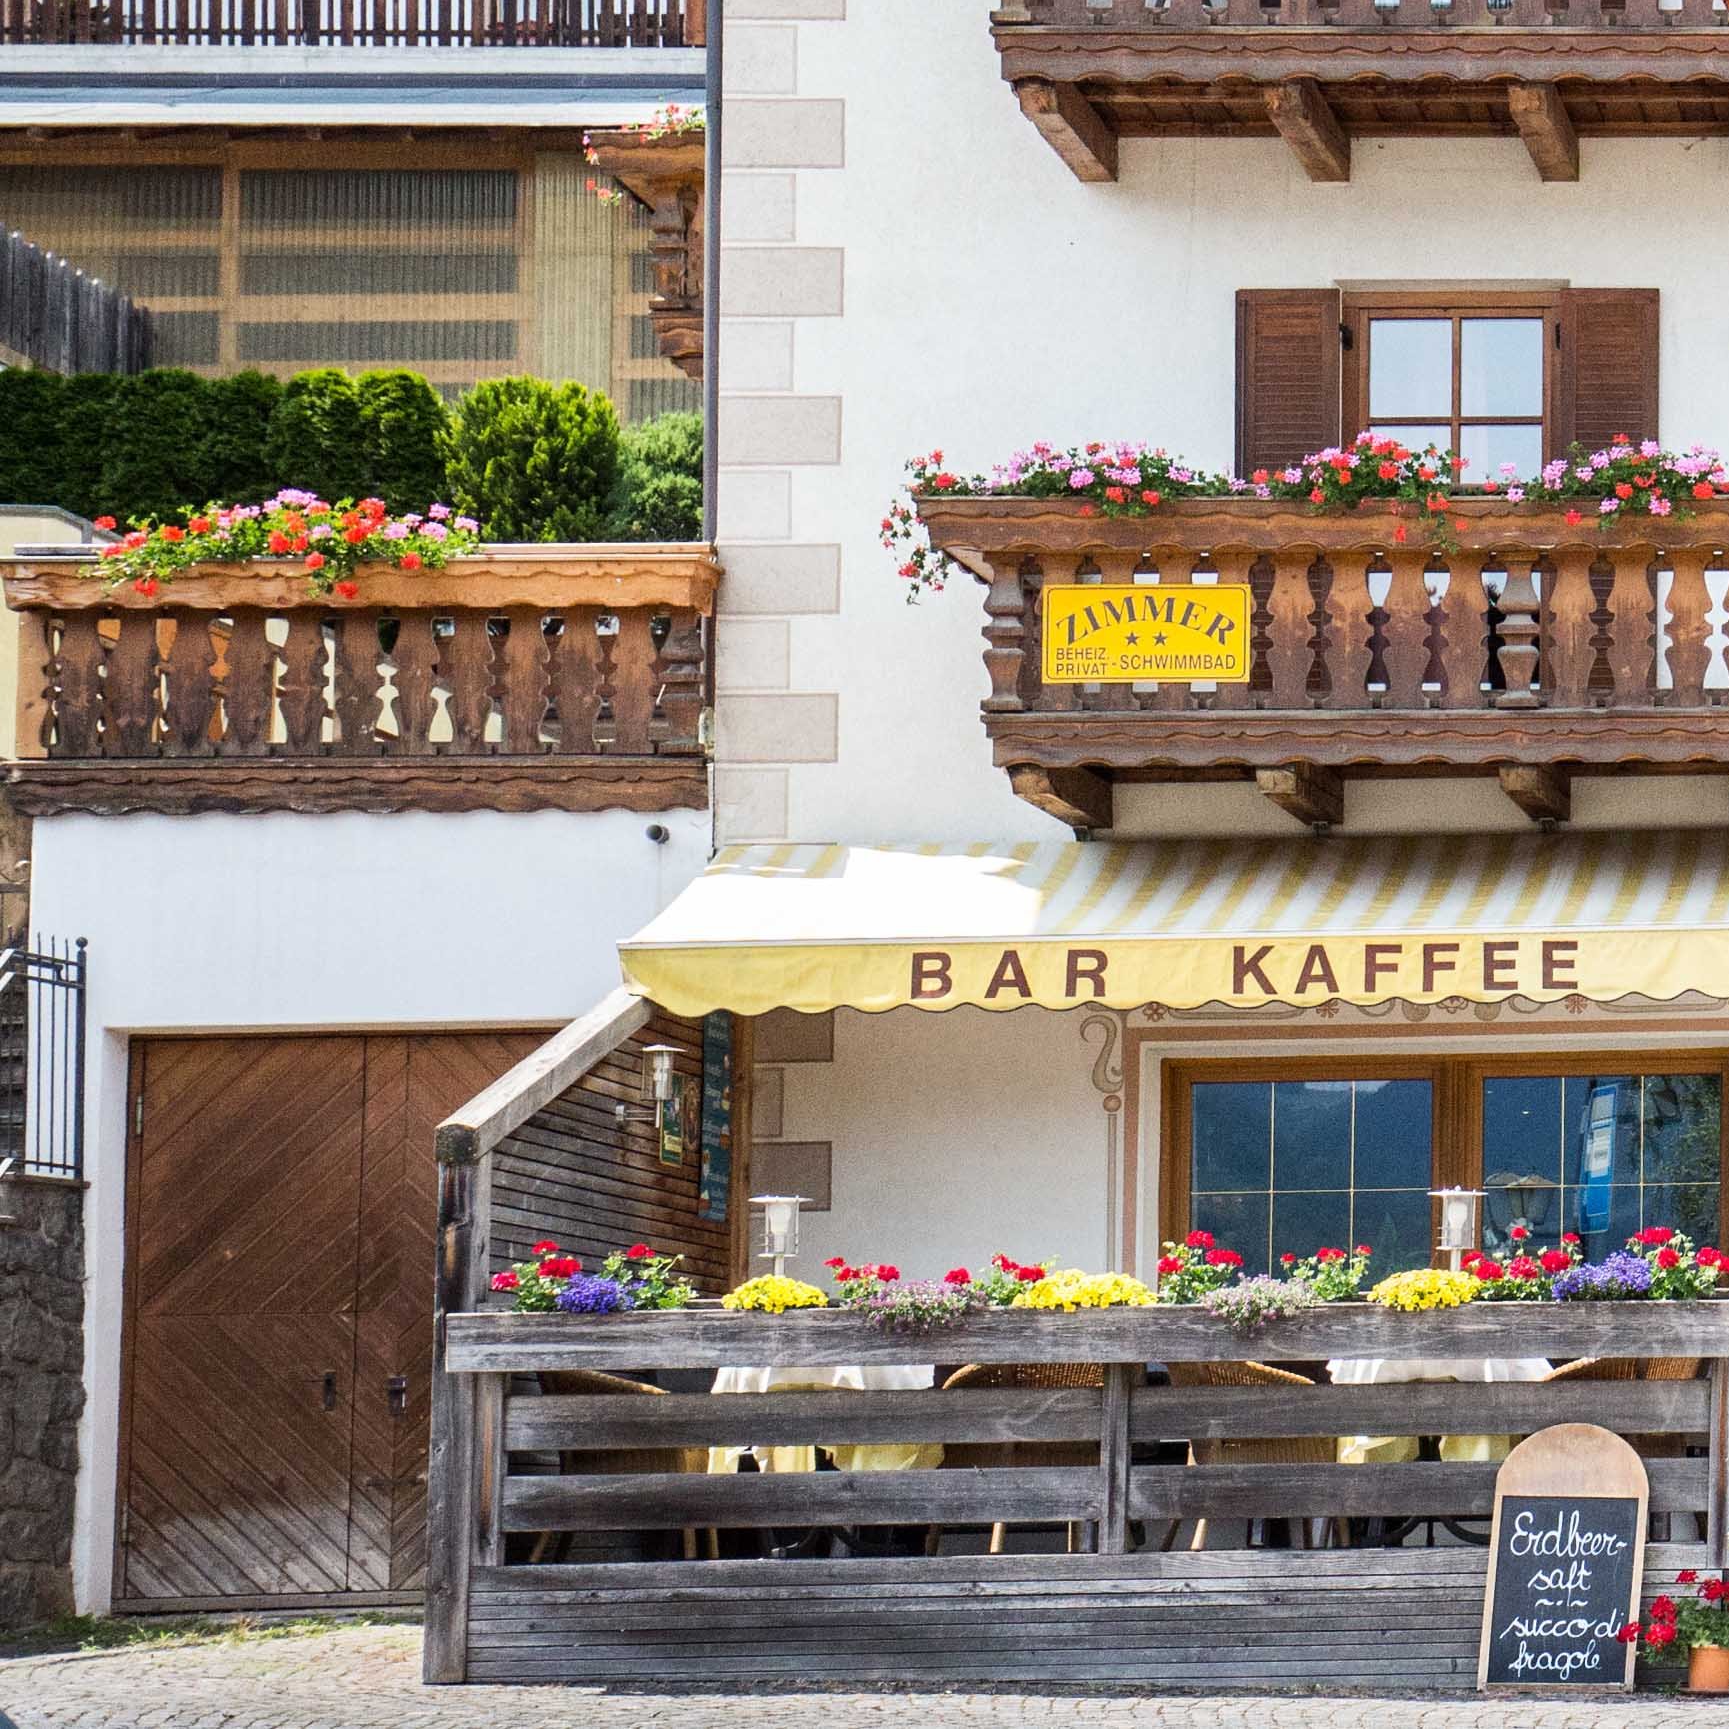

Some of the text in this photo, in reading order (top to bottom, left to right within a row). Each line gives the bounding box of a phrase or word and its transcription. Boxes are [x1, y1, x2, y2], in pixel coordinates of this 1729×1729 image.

[1056, 595, 1235, 646] ZIMMER
[1056, 647, 1110, 661] BEHEIZ.
[1056, 662, 1108, 676] PRIVAT
[910, 940, 1578, 1000] BAR KAFFEE
[1510, 1510, 1627, 1557] Erdbeer-
[1528, 1560, 1592, 1598] saft
[1500, 1608, 1625, 1639] succo di
[1508, 1638, 1602, 1681] fragole
